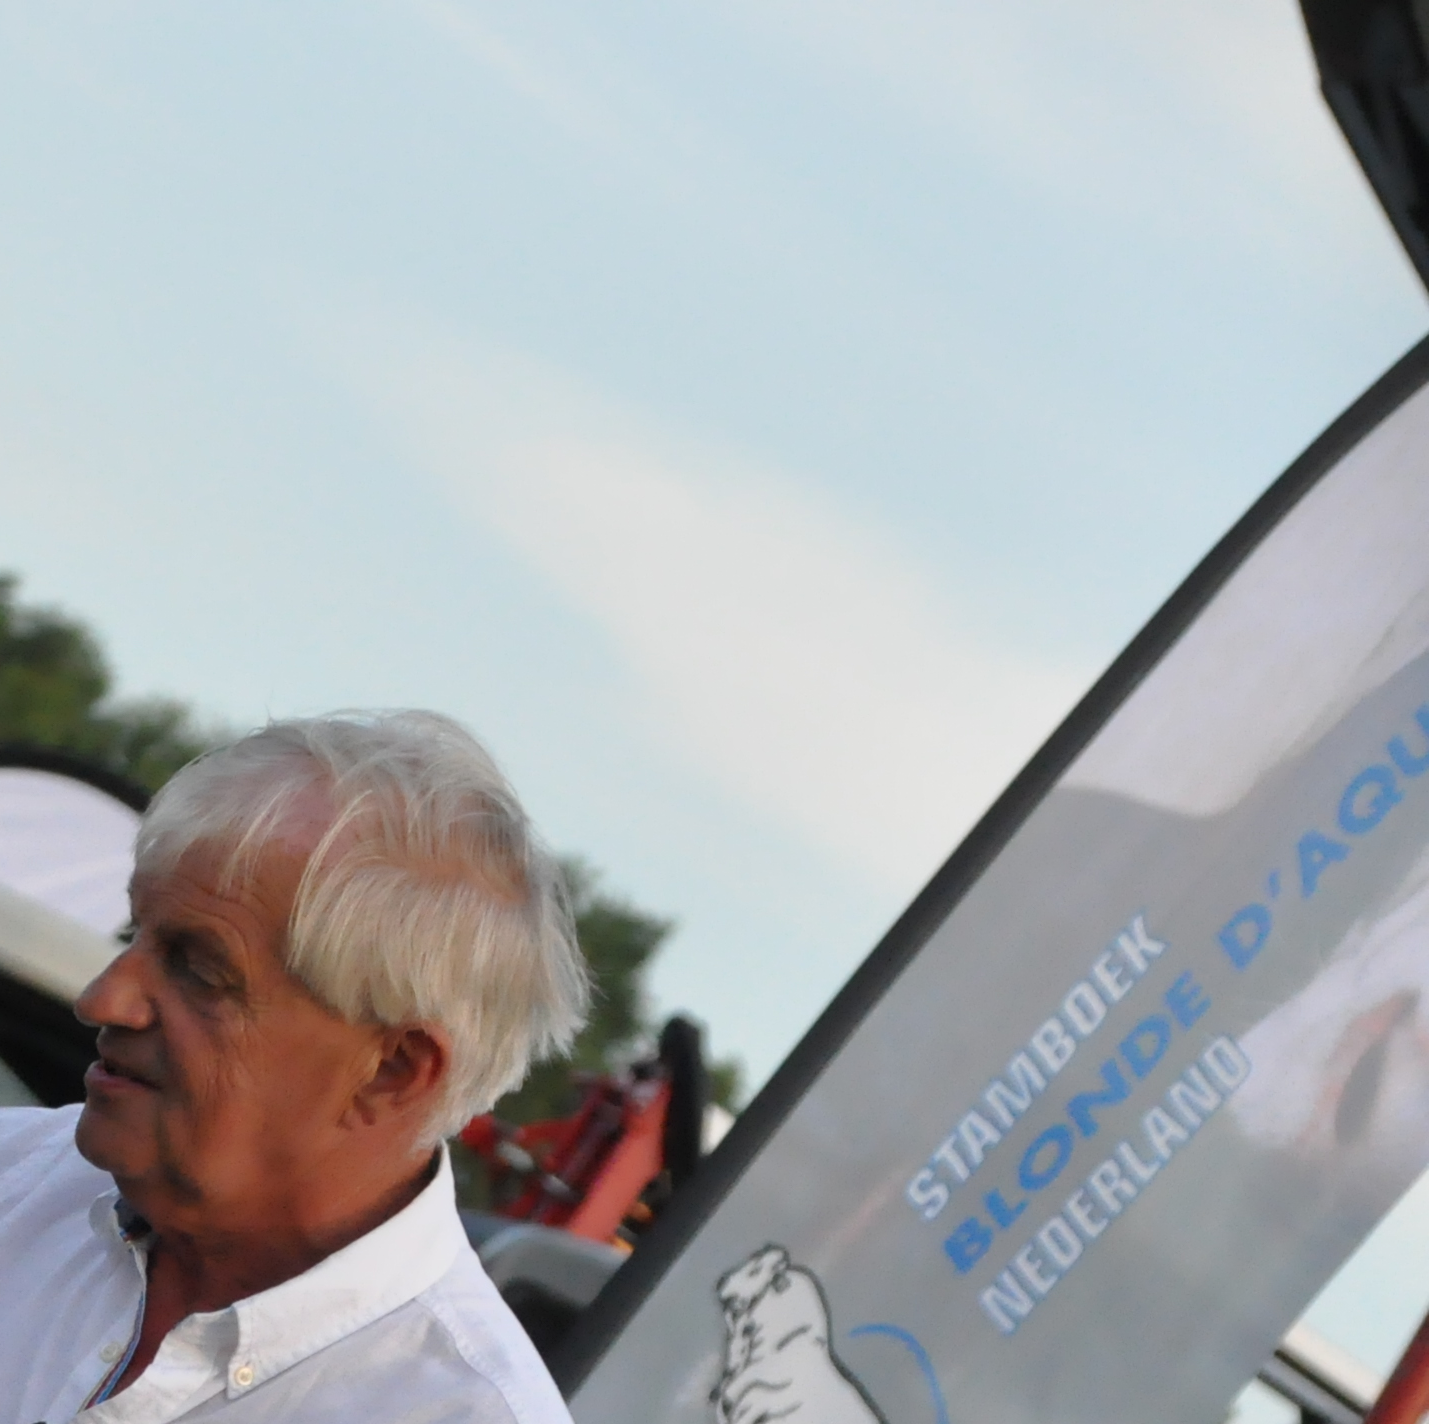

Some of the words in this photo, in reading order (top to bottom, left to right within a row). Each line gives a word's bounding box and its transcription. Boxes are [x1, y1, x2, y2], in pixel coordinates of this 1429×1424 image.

[907, 911, 1168, 1221] STAMBOEK
[944, 970, 1211, 1274] BLONDE
[980, 1034, 1251, 1334] NEDERLAND
